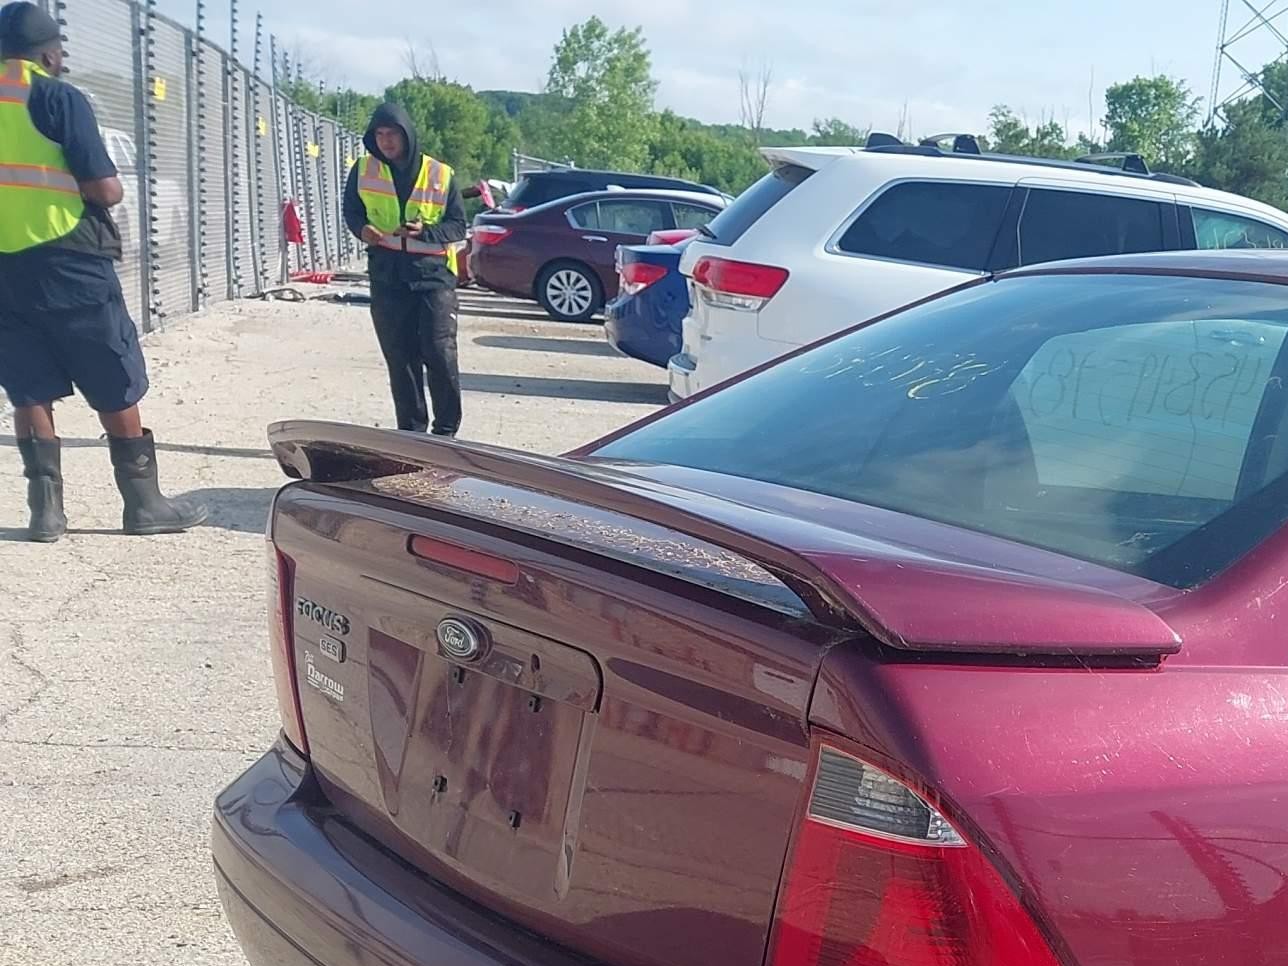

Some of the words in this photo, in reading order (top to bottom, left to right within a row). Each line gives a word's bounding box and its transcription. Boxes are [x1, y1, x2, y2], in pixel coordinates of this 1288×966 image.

[296, 596, 350, 635] FOCUS
[320, 639, 338, 657] SES
[444, 625, 465, 649] Ford
